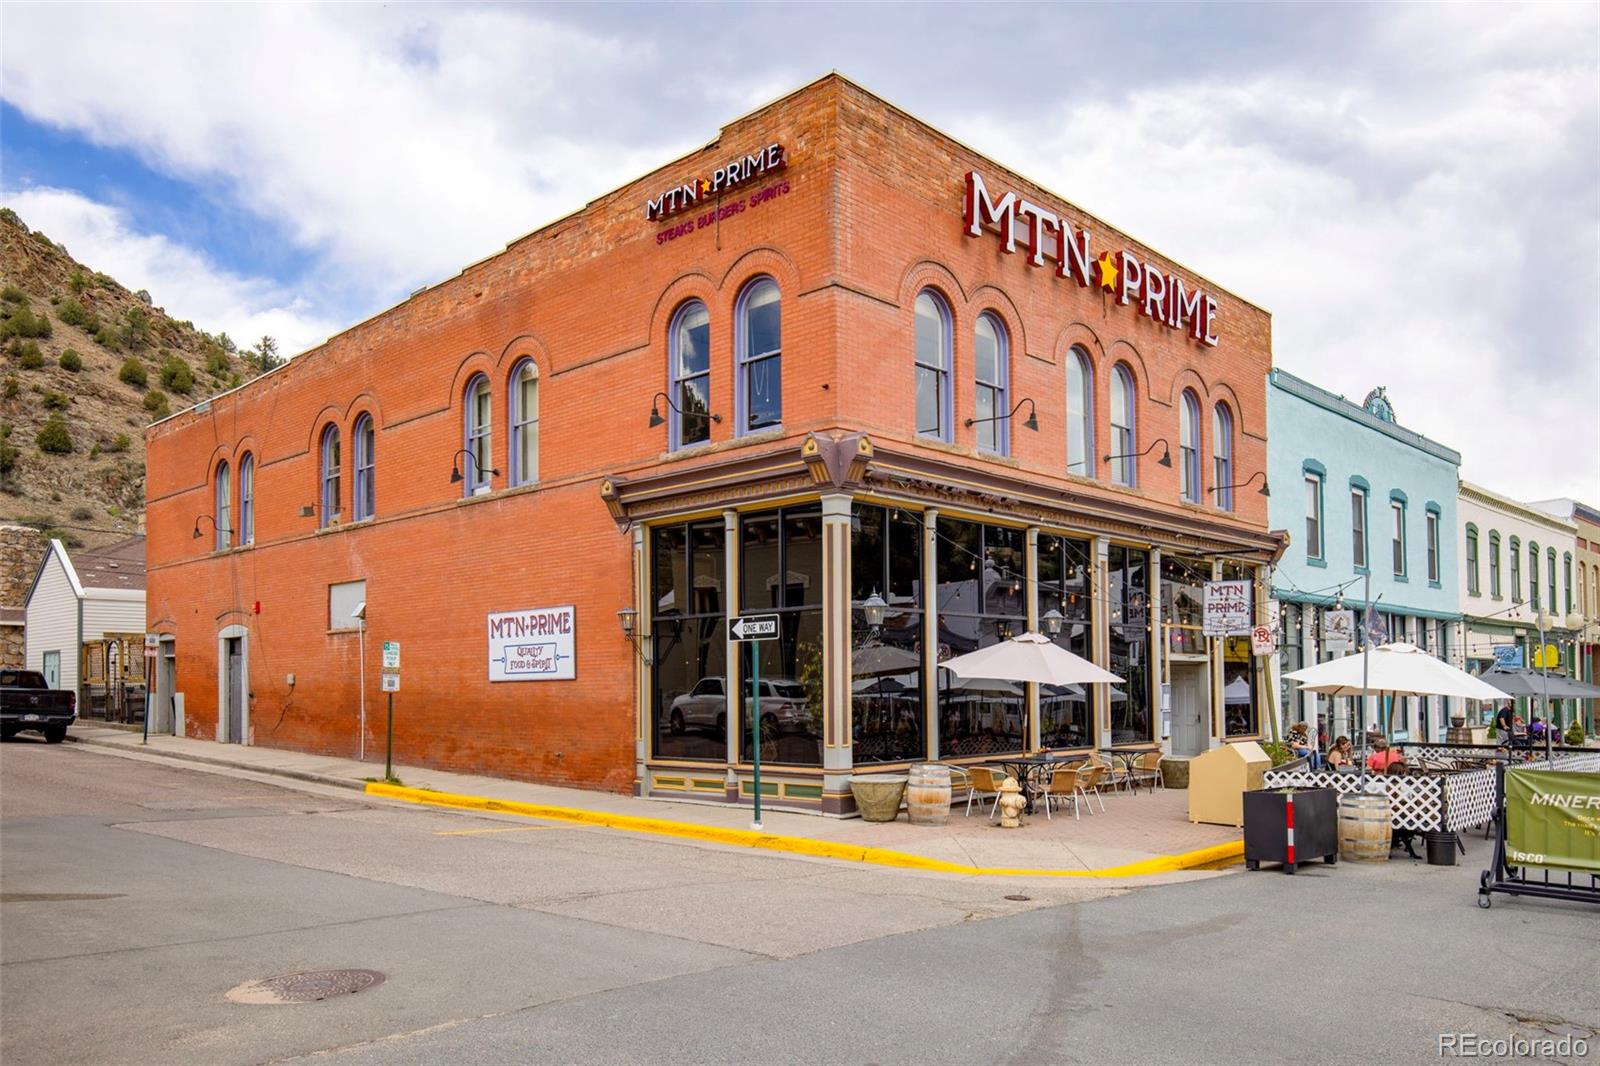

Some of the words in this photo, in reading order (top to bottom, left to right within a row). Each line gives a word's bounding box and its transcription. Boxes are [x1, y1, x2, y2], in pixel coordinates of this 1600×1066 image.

[646, 179, 698, 220] MTN
[713, 143, 782, 192] PRIME
[656, 220, 694, 245] STEAKS
[697, 200, 746, 230] BURGERS
[749, 181, 790, 208] SPIRITS
[966, 171, 1090, 287] MTN
[1116, 250, 1219, 346] PRIME
[1210, 585, 1244, 597] MTN
[1208, 602, 1245, 613] PRIME
[490, 615, 526, 640] MTN
[530, 611, 571, 636] PRIME
[743, 623, 757, 634] ONE
[759, 622, 774, 632] WAY
[510, 659, 525, 670] FOOD
[1512, 850, 1545, 864] ISCO
